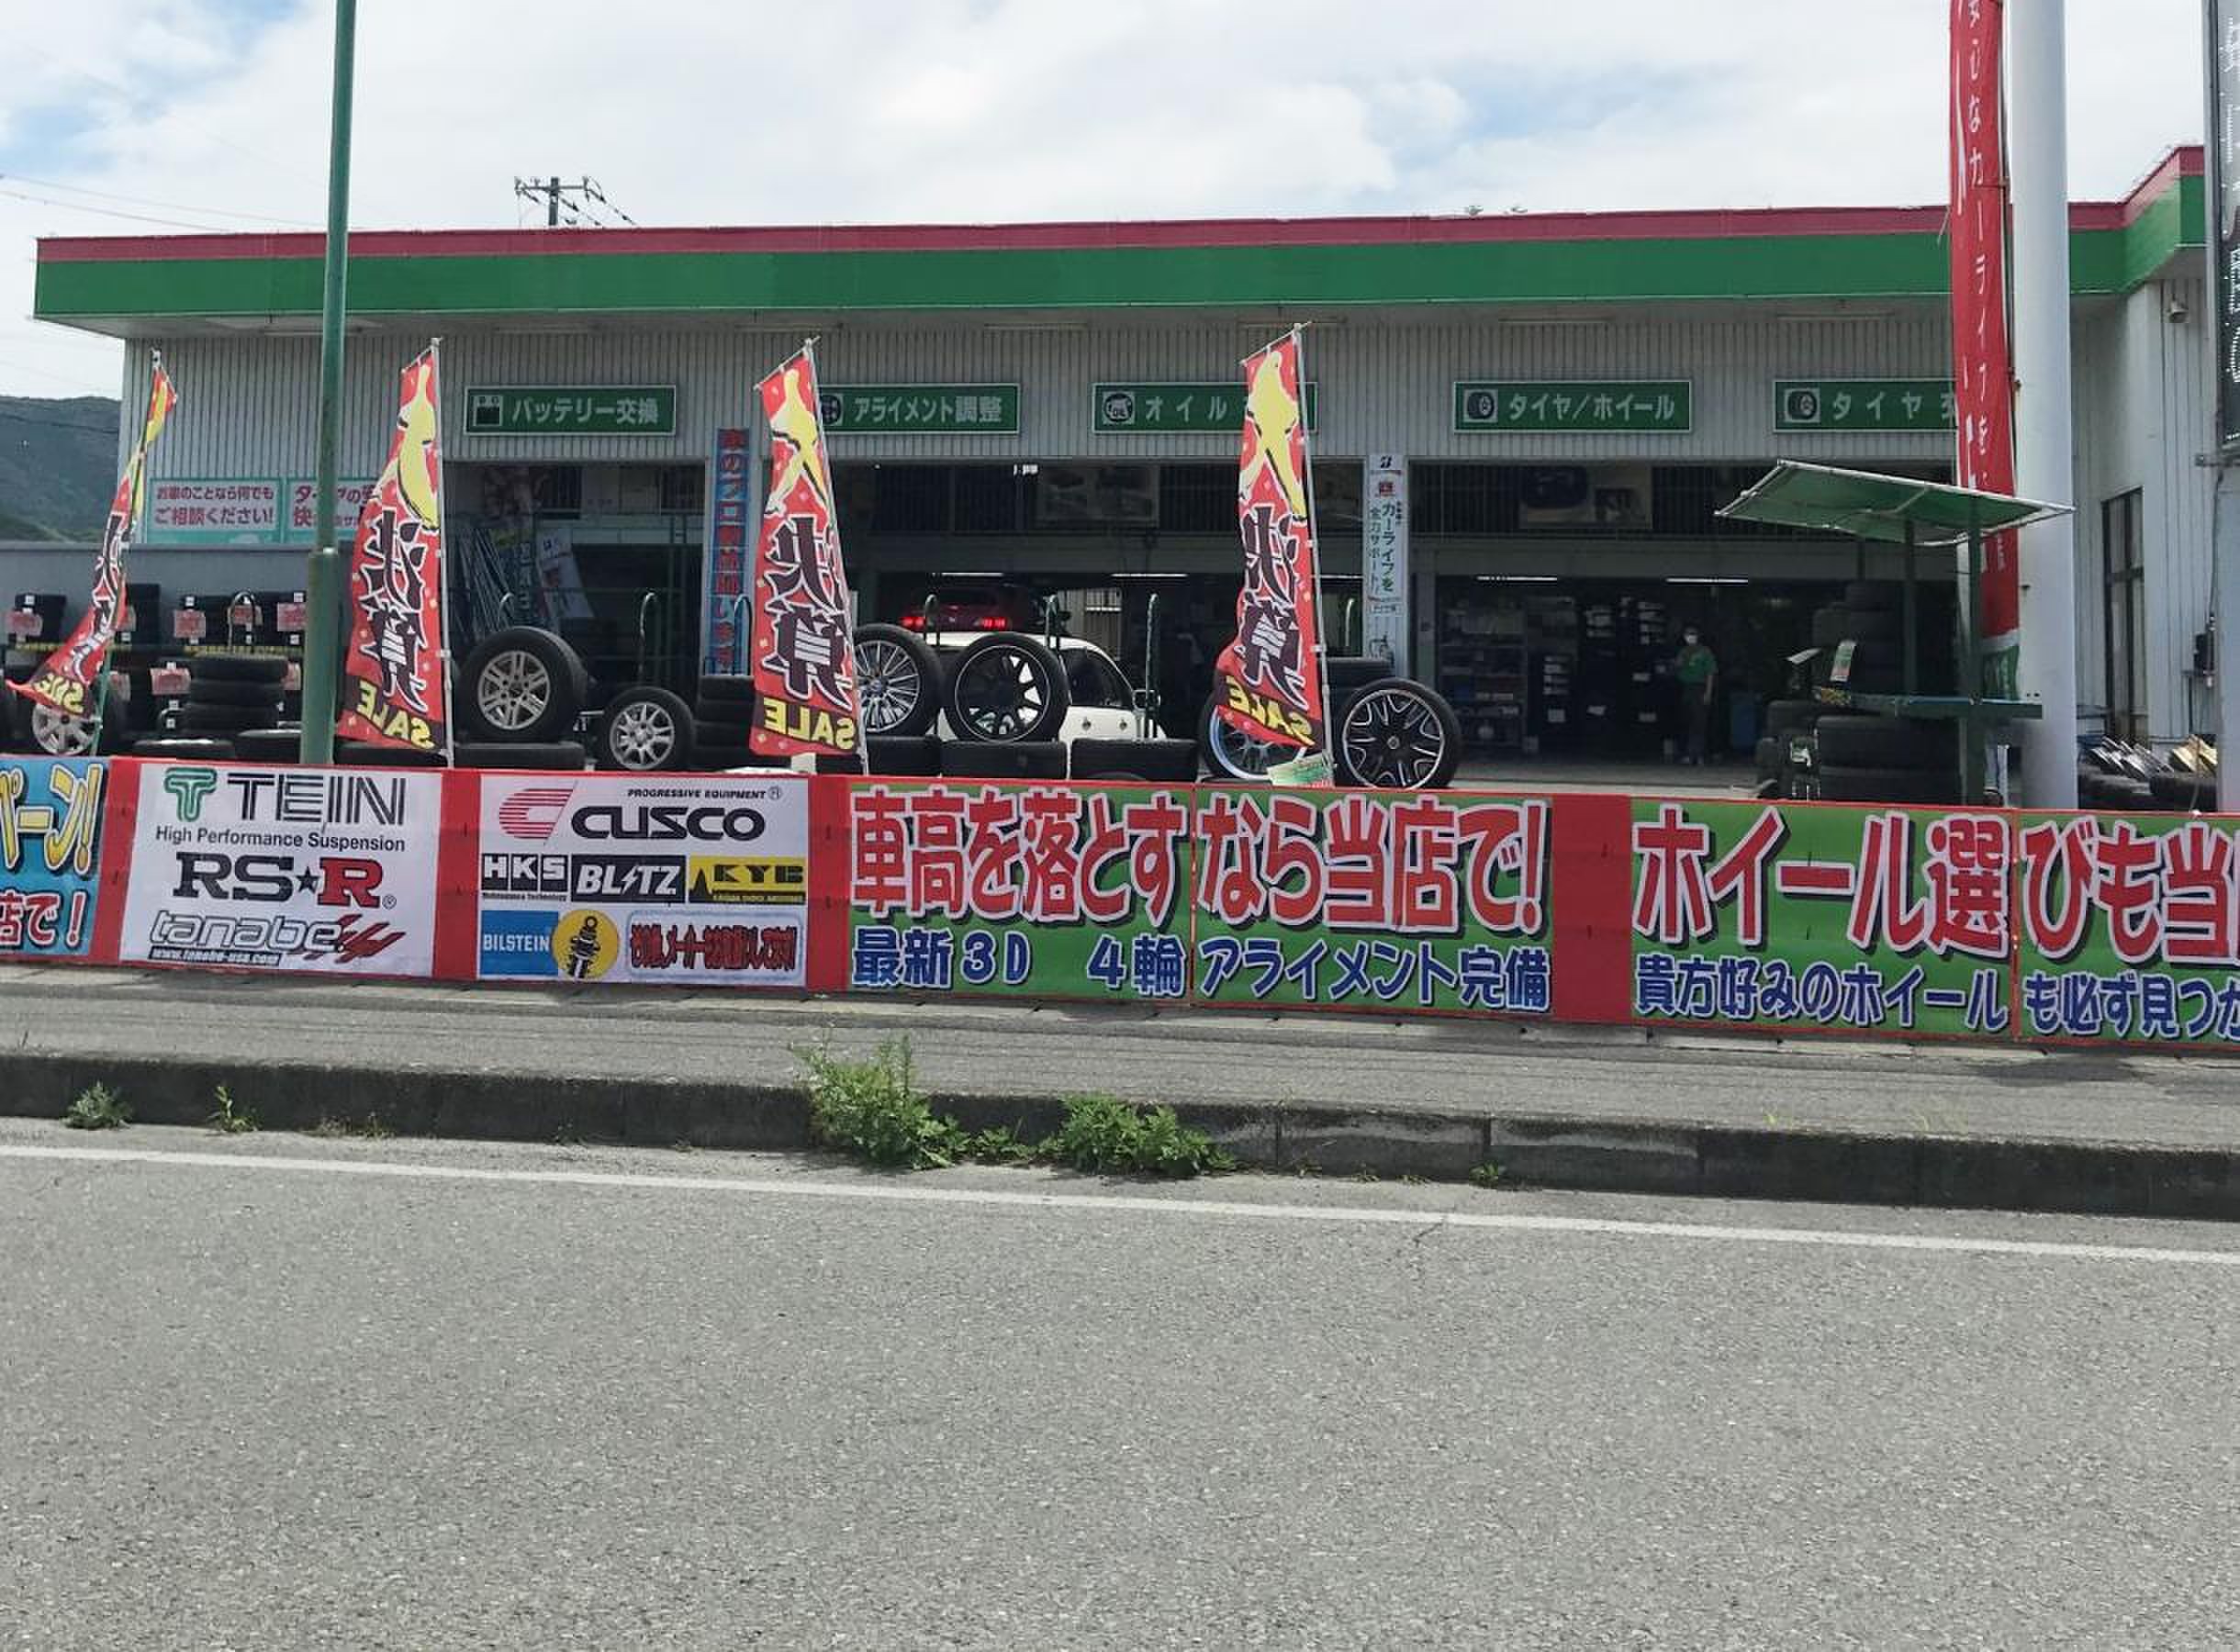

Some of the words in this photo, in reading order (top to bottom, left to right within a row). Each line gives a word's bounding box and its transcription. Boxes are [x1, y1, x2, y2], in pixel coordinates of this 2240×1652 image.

[510, 396, 659, 426] バッテリー交換
[853, 396, 1003, 424] アライメント調整
[1145, 396, 1248, 423] オイル
[154, 506, 274, 526] ご相談ください!
[228, 772, 407, 826] TEIN
[627, 788, 701, 799] PROGRESSIVE
[704, 789, 767, 800] EQUIPMENT
[571, 806, 766, 842] CUSCO
[155, 825, 193, 845] High
[196, 828, 303, 848] Performance
[308, 832, 406, 853] Suspension
[483, 854, 566, 881] HKS
[713, 864, 804, 884] KYB
[1631, 803, 2240, 966] ホイール選びも当
[149, 910, 345, 954] tanabe
[483, 933, 550, 954] BILSTEIN
